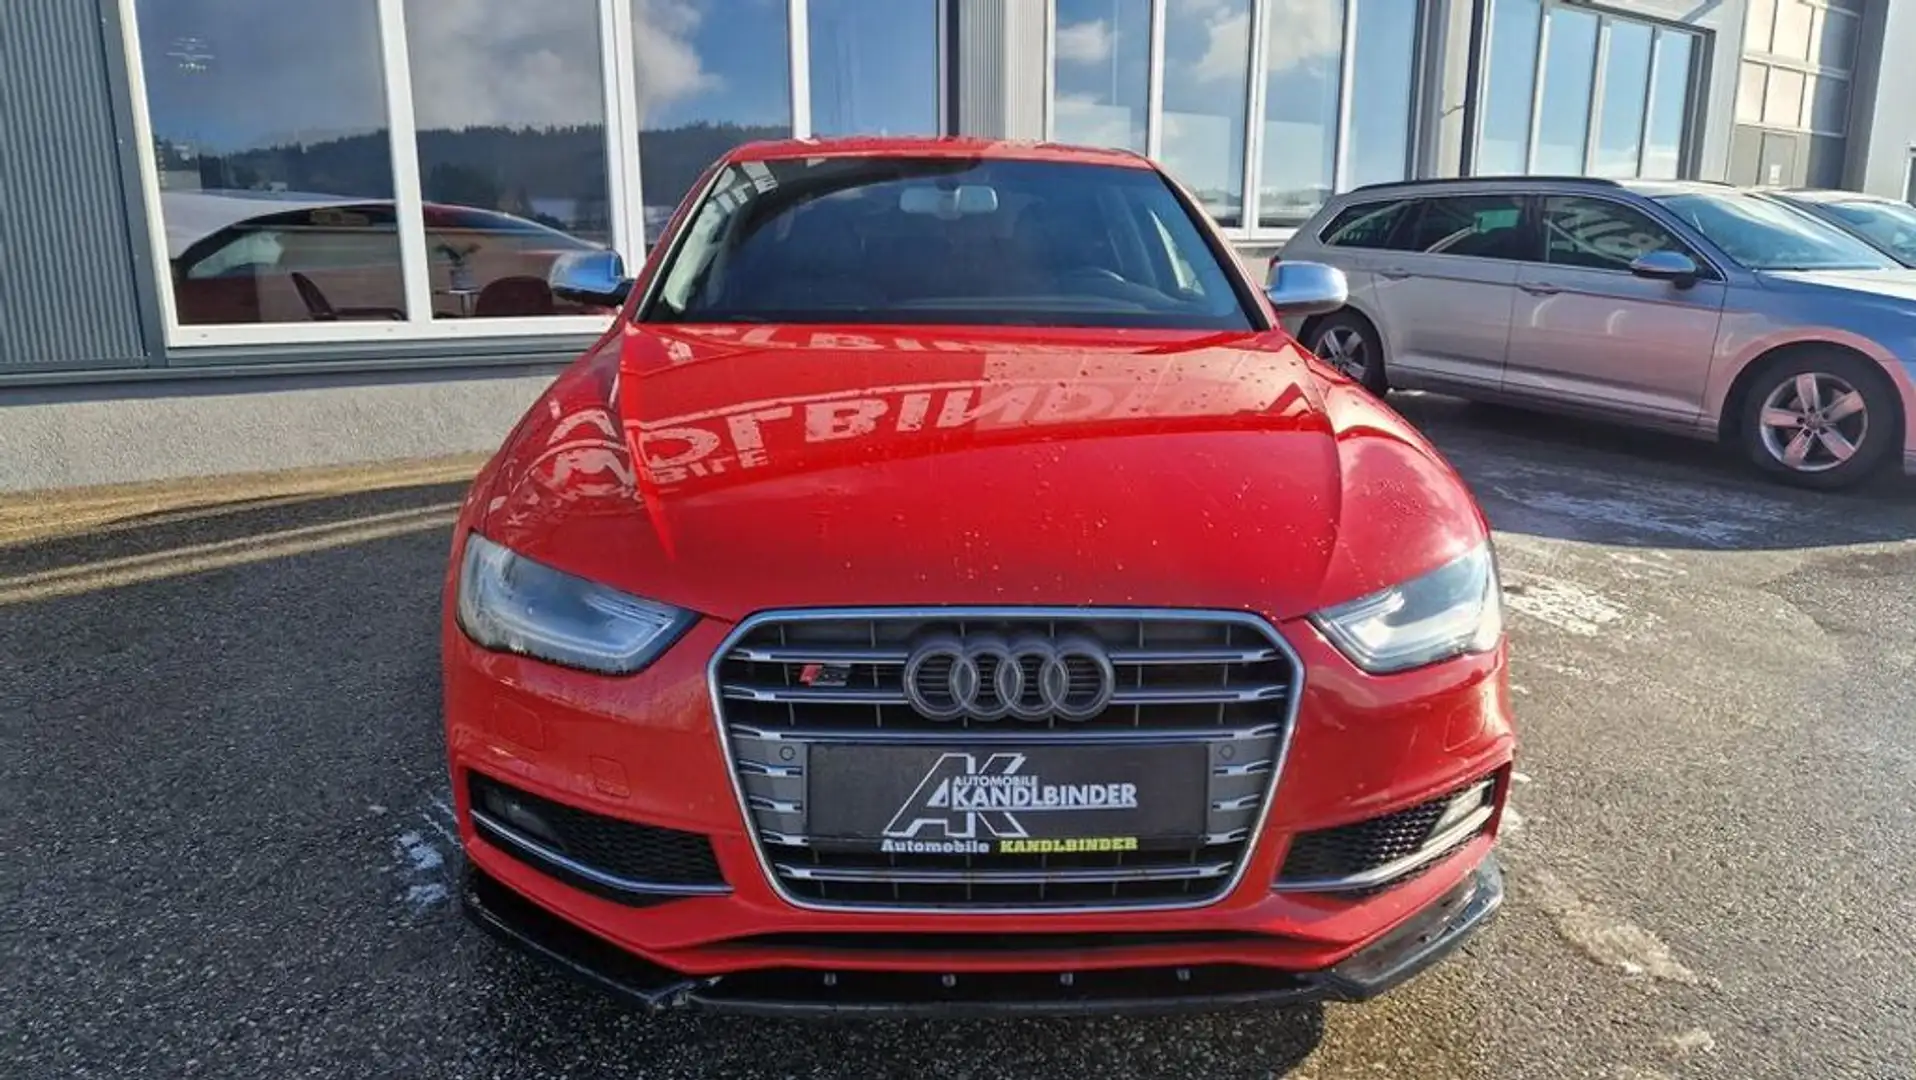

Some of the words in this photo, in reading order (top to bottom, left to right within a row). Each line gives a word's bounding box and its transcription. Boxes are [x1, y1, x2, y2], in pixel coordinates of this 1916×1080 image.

[953, 775, 1038, 787] AUTOMOBILE
[953, 784, 1138, 806] KANDLBINDER
[881, 839, 990, 853] Automobile
[1000, 837, 1138, 853] KANDLBINDER
